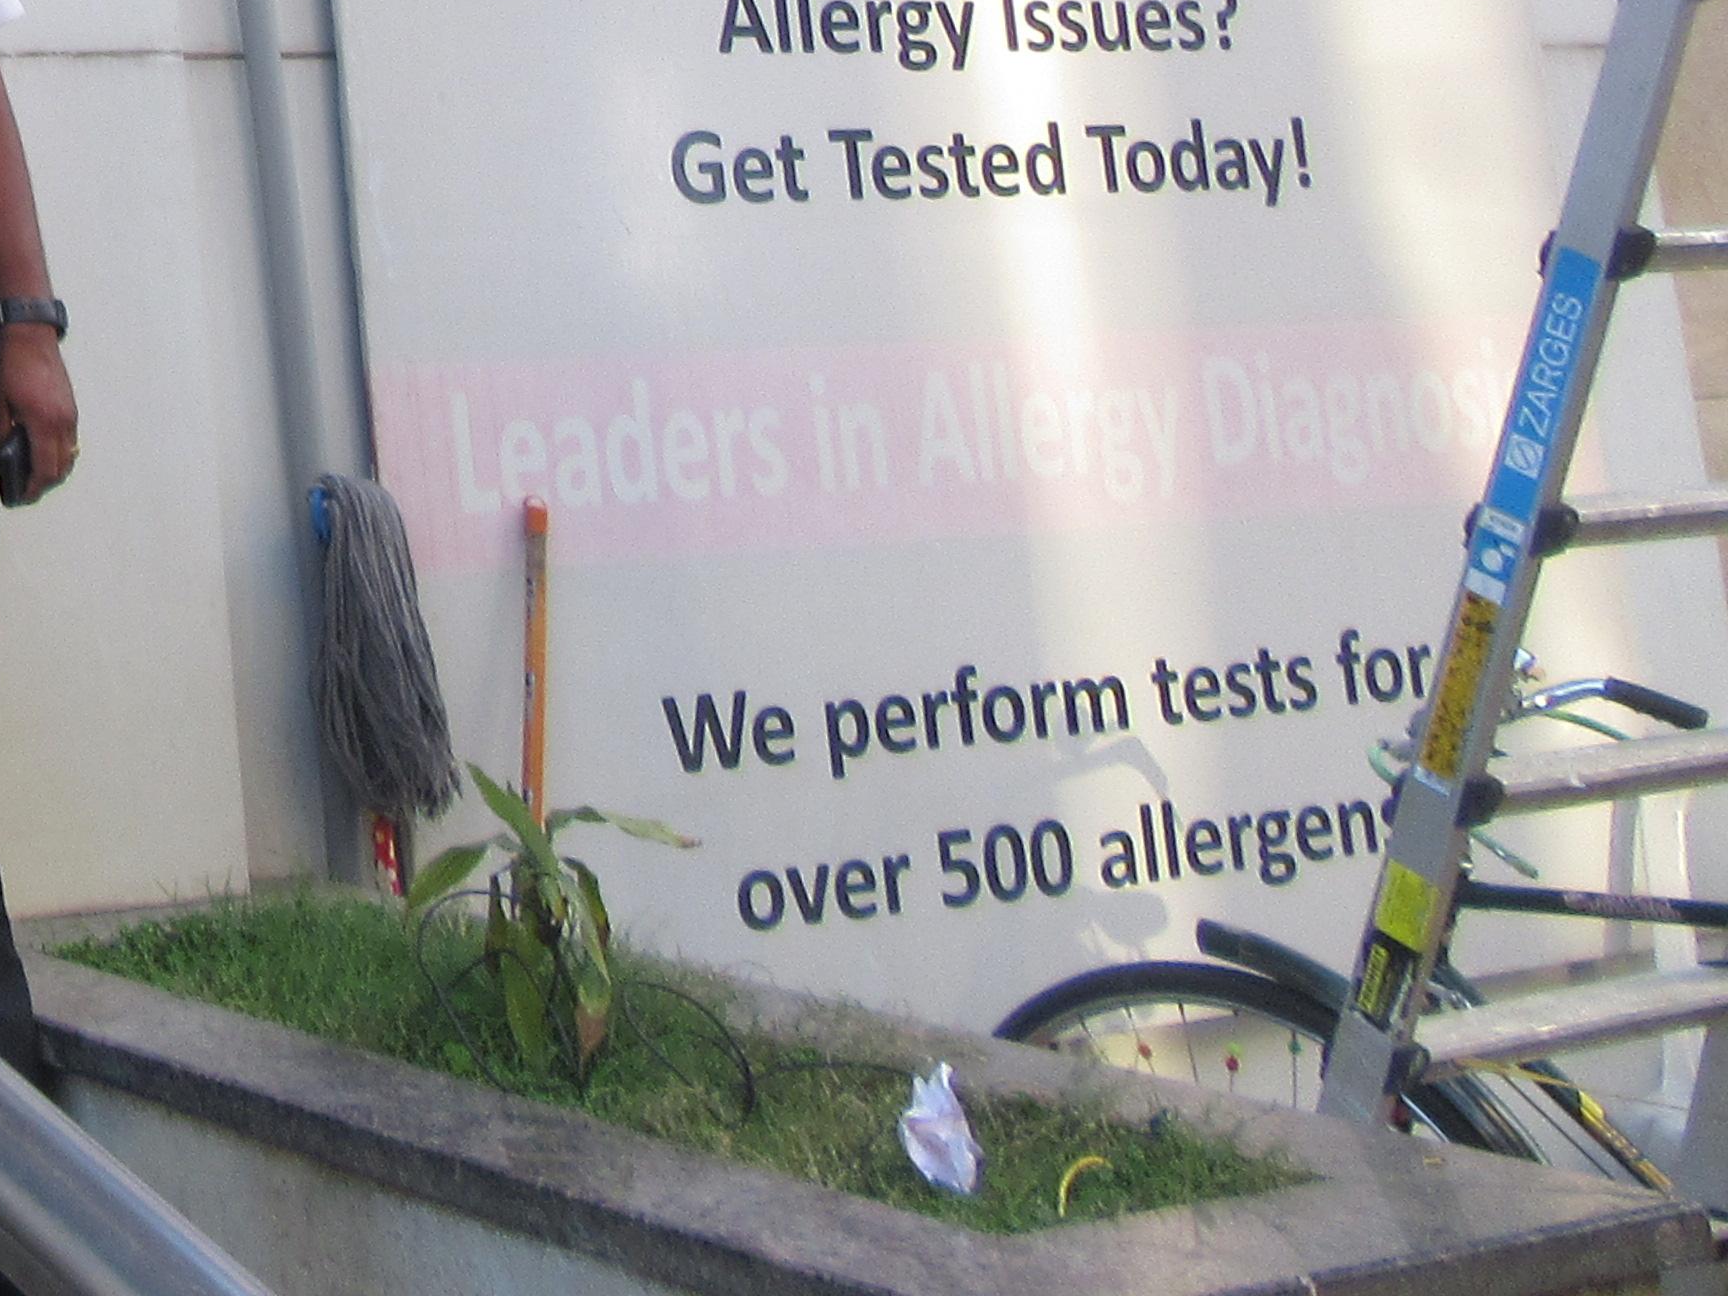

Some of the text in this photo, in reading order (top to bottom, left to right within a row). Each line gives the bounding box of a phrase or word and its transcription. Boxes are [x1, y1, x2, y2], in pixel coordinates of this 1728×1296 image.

[671, 117, 1314, 207] Get Tested Today!
[450, 336, 1508, 514] Leaders in Allergy Diagnosi
[1519, 292, 1581, 439] ZARGES
[662, 690, 796, 774] We
[826, 664, 1130, 780] perform
[1151, 646, 1318, 727] tests
[1338, 629, 1433, 707] for
[739, 854, 912, 932] over
[938, 818, 1073, 909] 500
